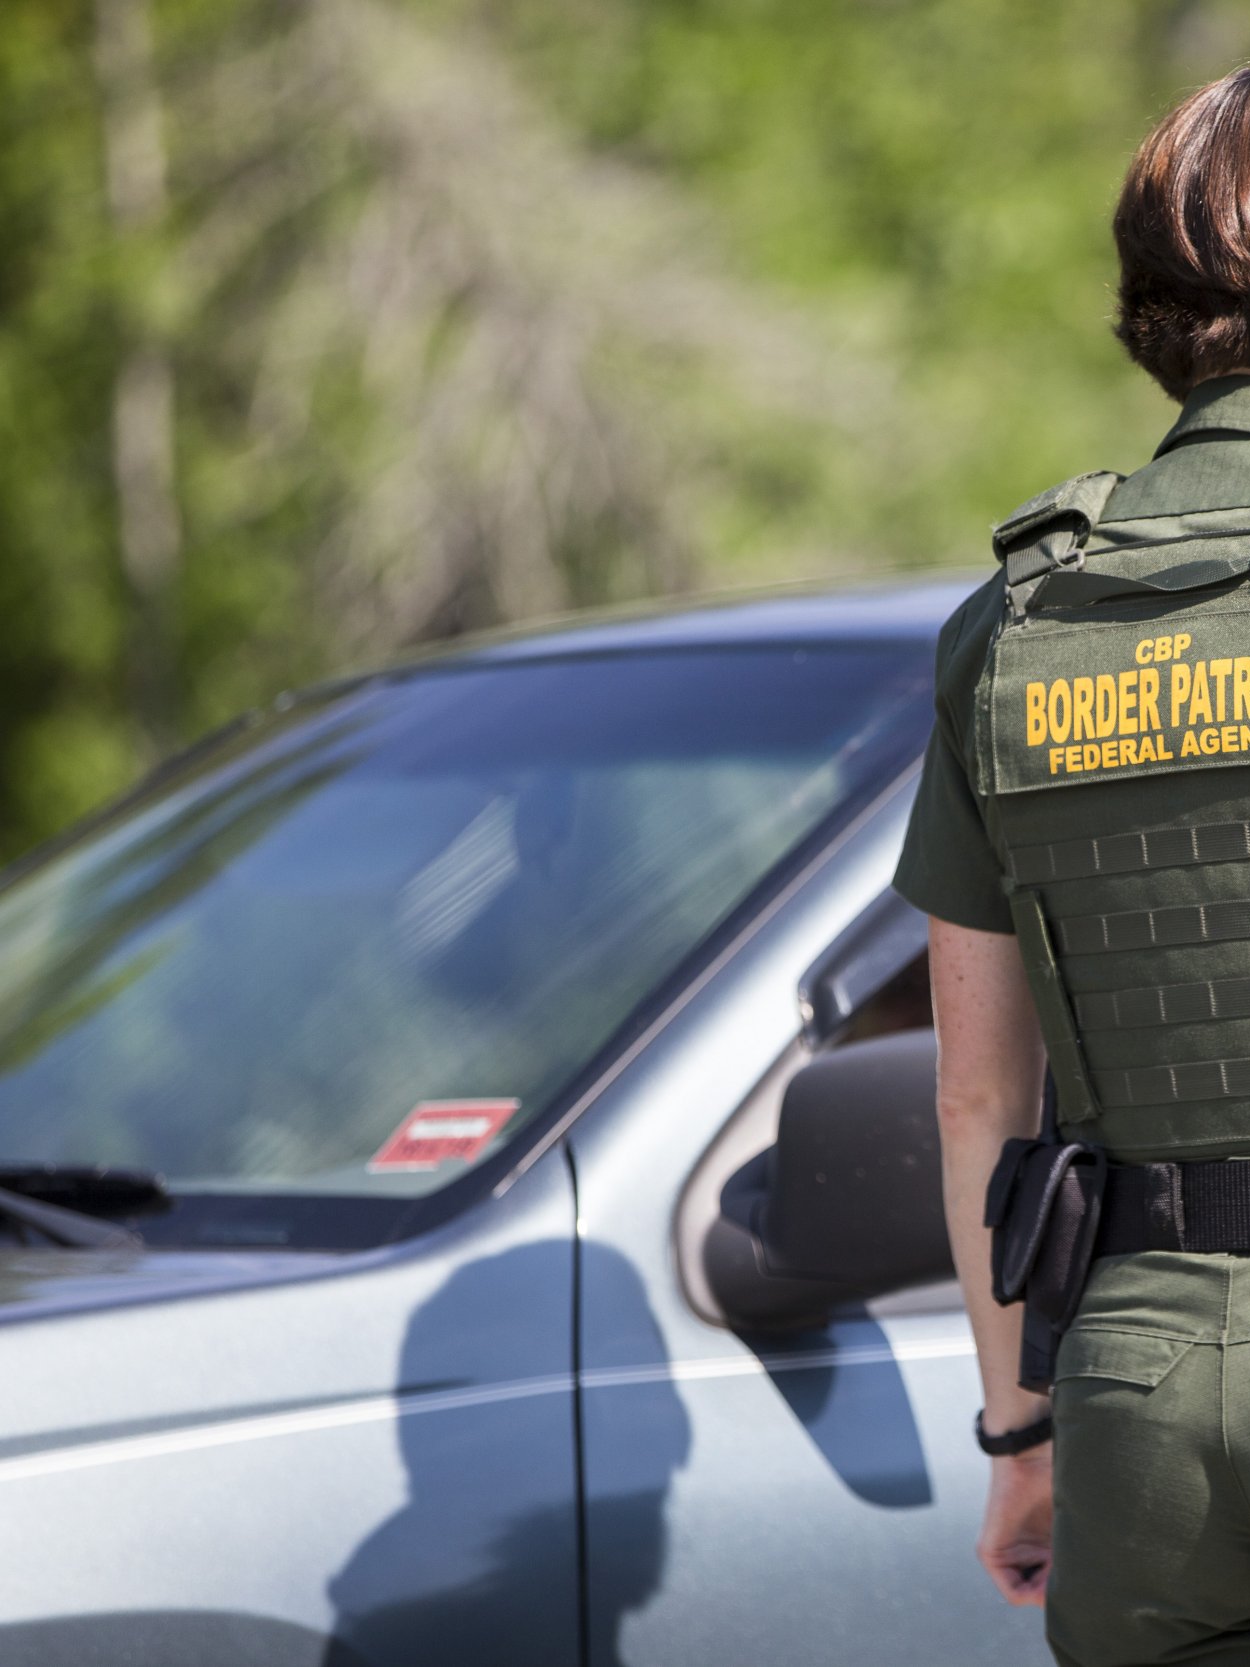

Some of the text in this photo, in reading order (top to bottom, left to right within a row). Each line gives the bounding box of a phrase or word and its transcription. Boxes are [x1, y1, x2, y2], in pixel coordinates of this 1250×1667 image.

[1135, 633, 1192, 664] CBP
[1026, 667, 1162, 747] BORDER
[1049, 734, 1174, 775] FEDERAL
